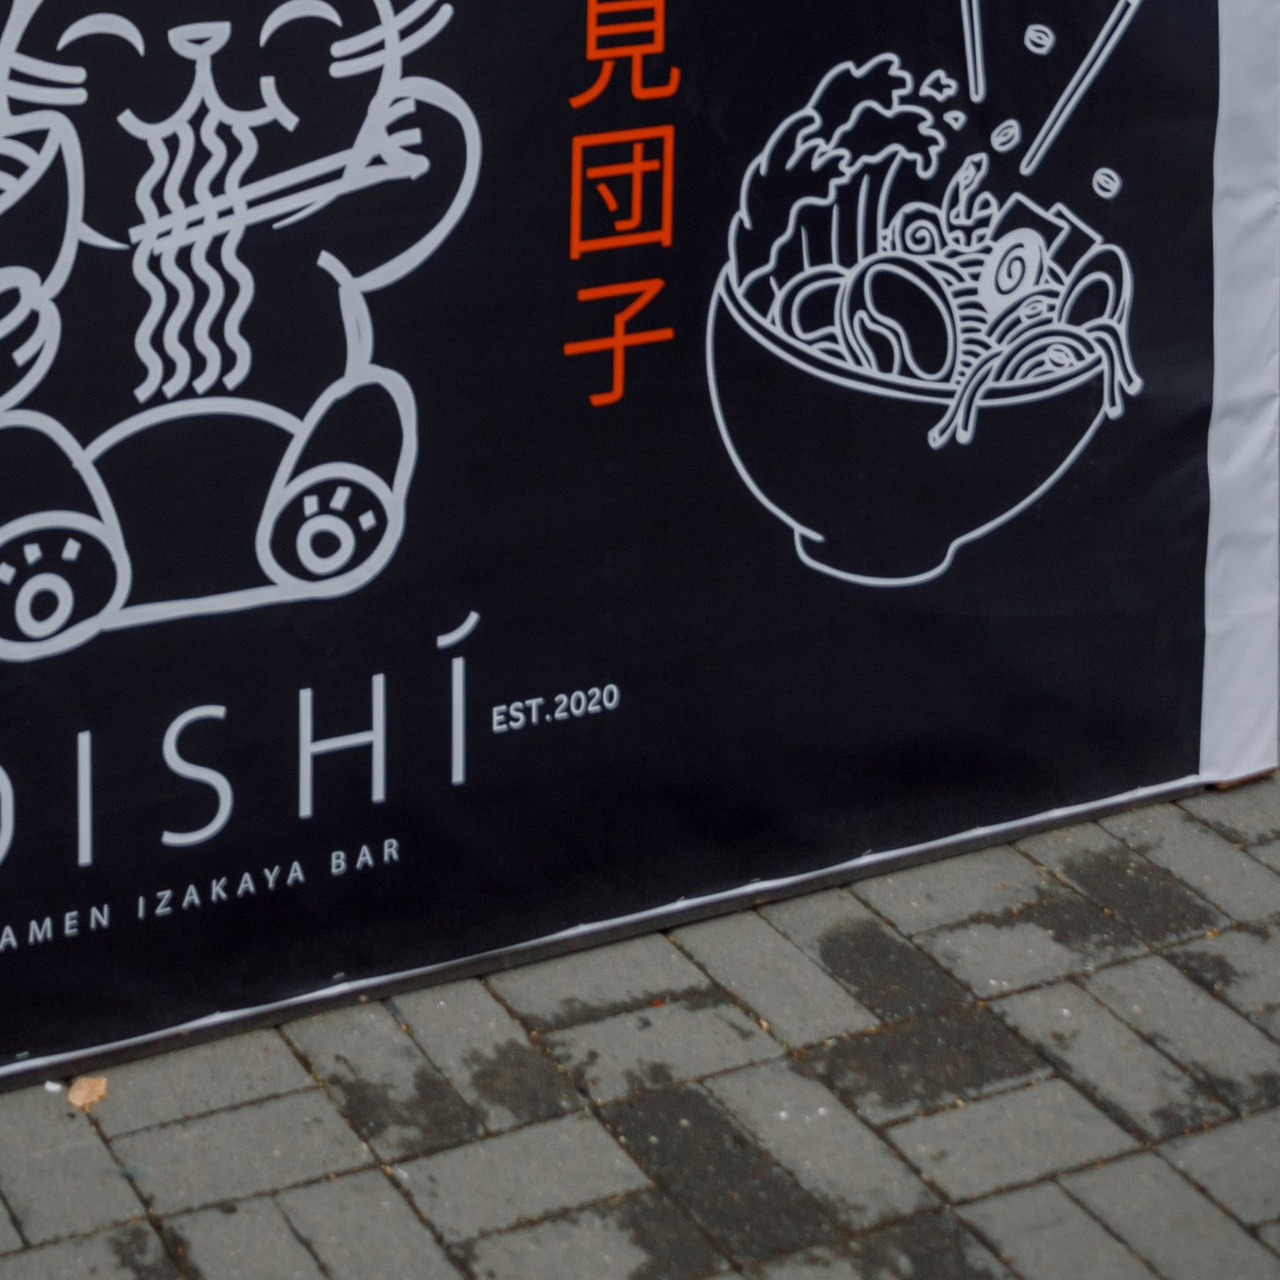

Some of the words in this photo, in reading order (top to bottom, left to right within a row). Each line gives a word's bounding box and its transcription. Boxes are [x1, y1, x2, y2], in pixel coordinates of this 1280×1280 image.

[491, 683, 621, 733] EST.2020
[137, 860, 307, 918] IZAKAYA
[331, 839, 402, 876] BAR
